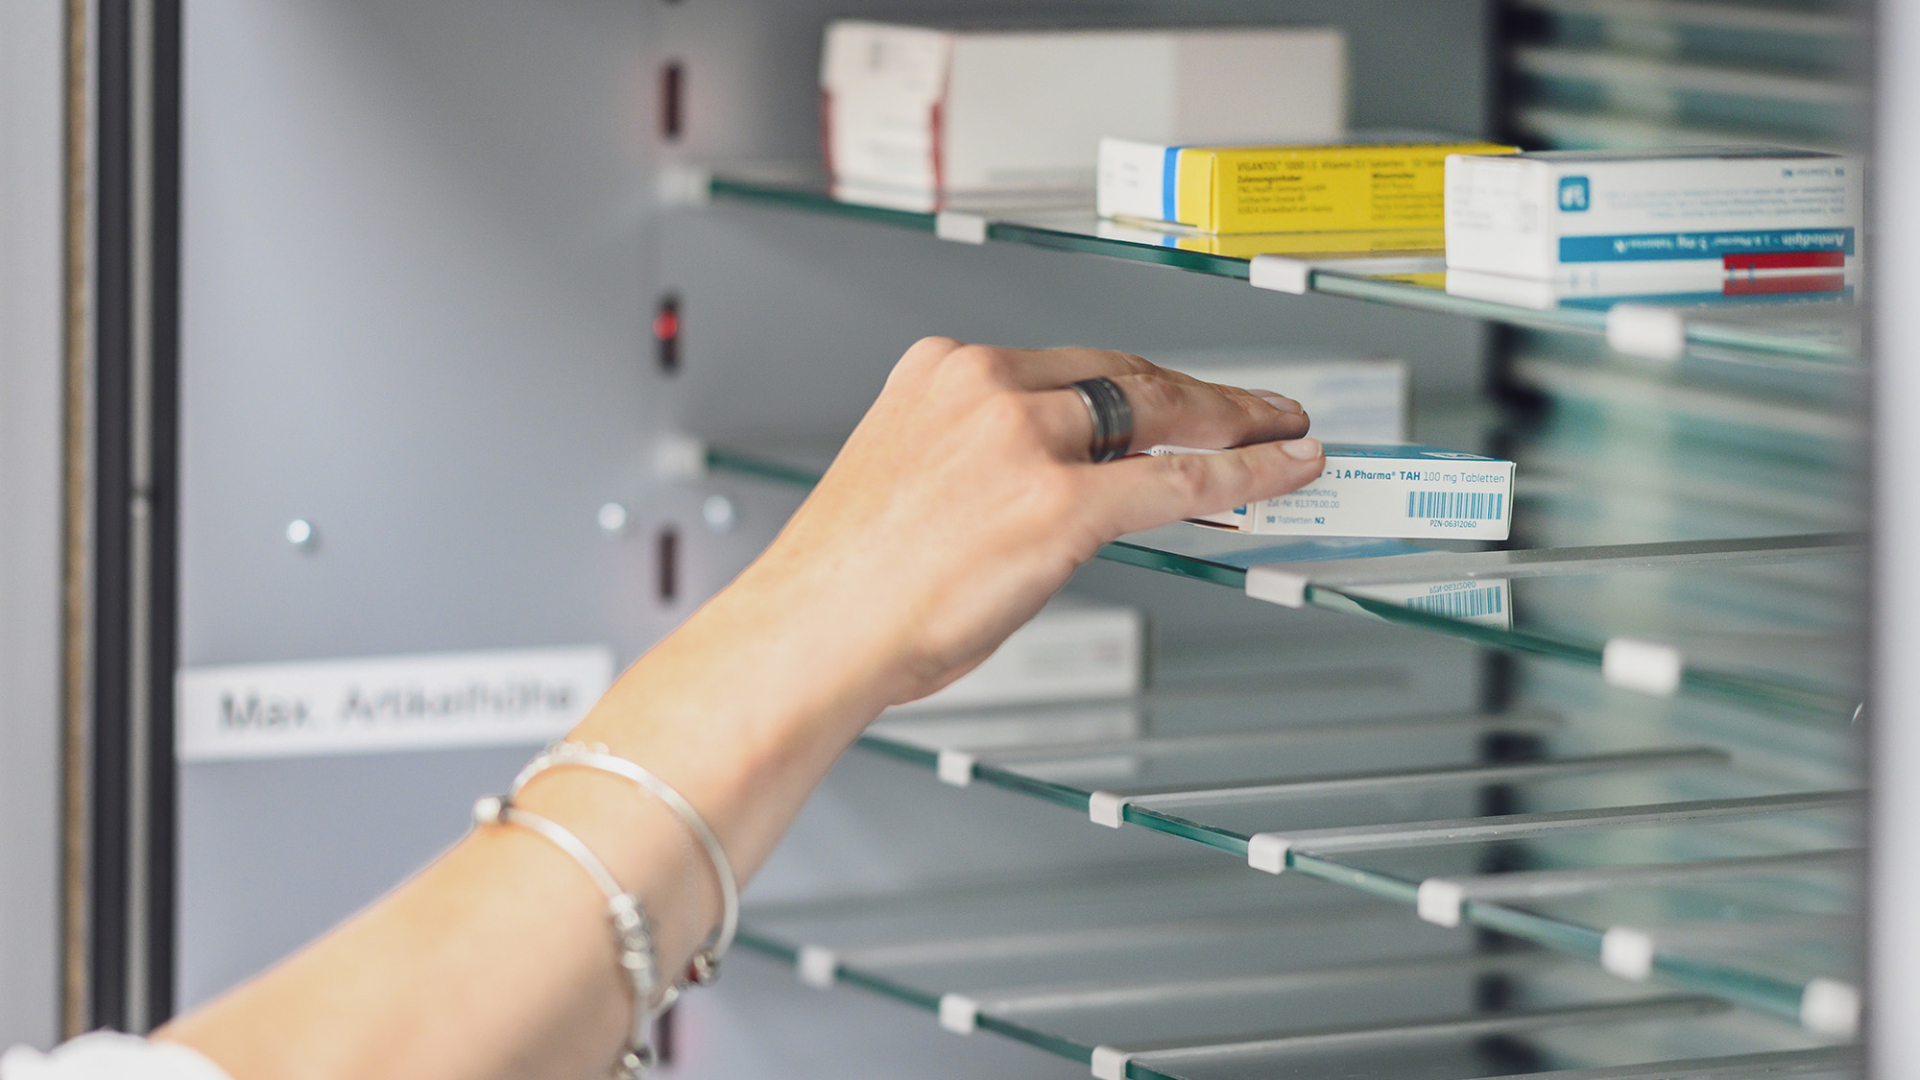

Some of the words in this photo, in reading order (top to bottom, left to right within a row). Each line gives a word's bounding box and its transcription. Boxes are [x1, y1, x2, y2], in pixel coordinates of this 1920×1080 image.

[1335, 469, 1341, 479] 1
[1344, 469, 1352, 479] A
[1354, 469, 1396, 480] Pharma®
[1399, 471, 1421, 481] TAH
[1423, 471, 1441, 481] 100
[1443, 473, 1457, 484] mg
[1460, 472, 1505, 484] Tabletten
[1278, 515, 1313, 524] Tabletten
[1314, 516, 1326, 524] N2
[1429, 519, 1477, 529] PZN-06312060
